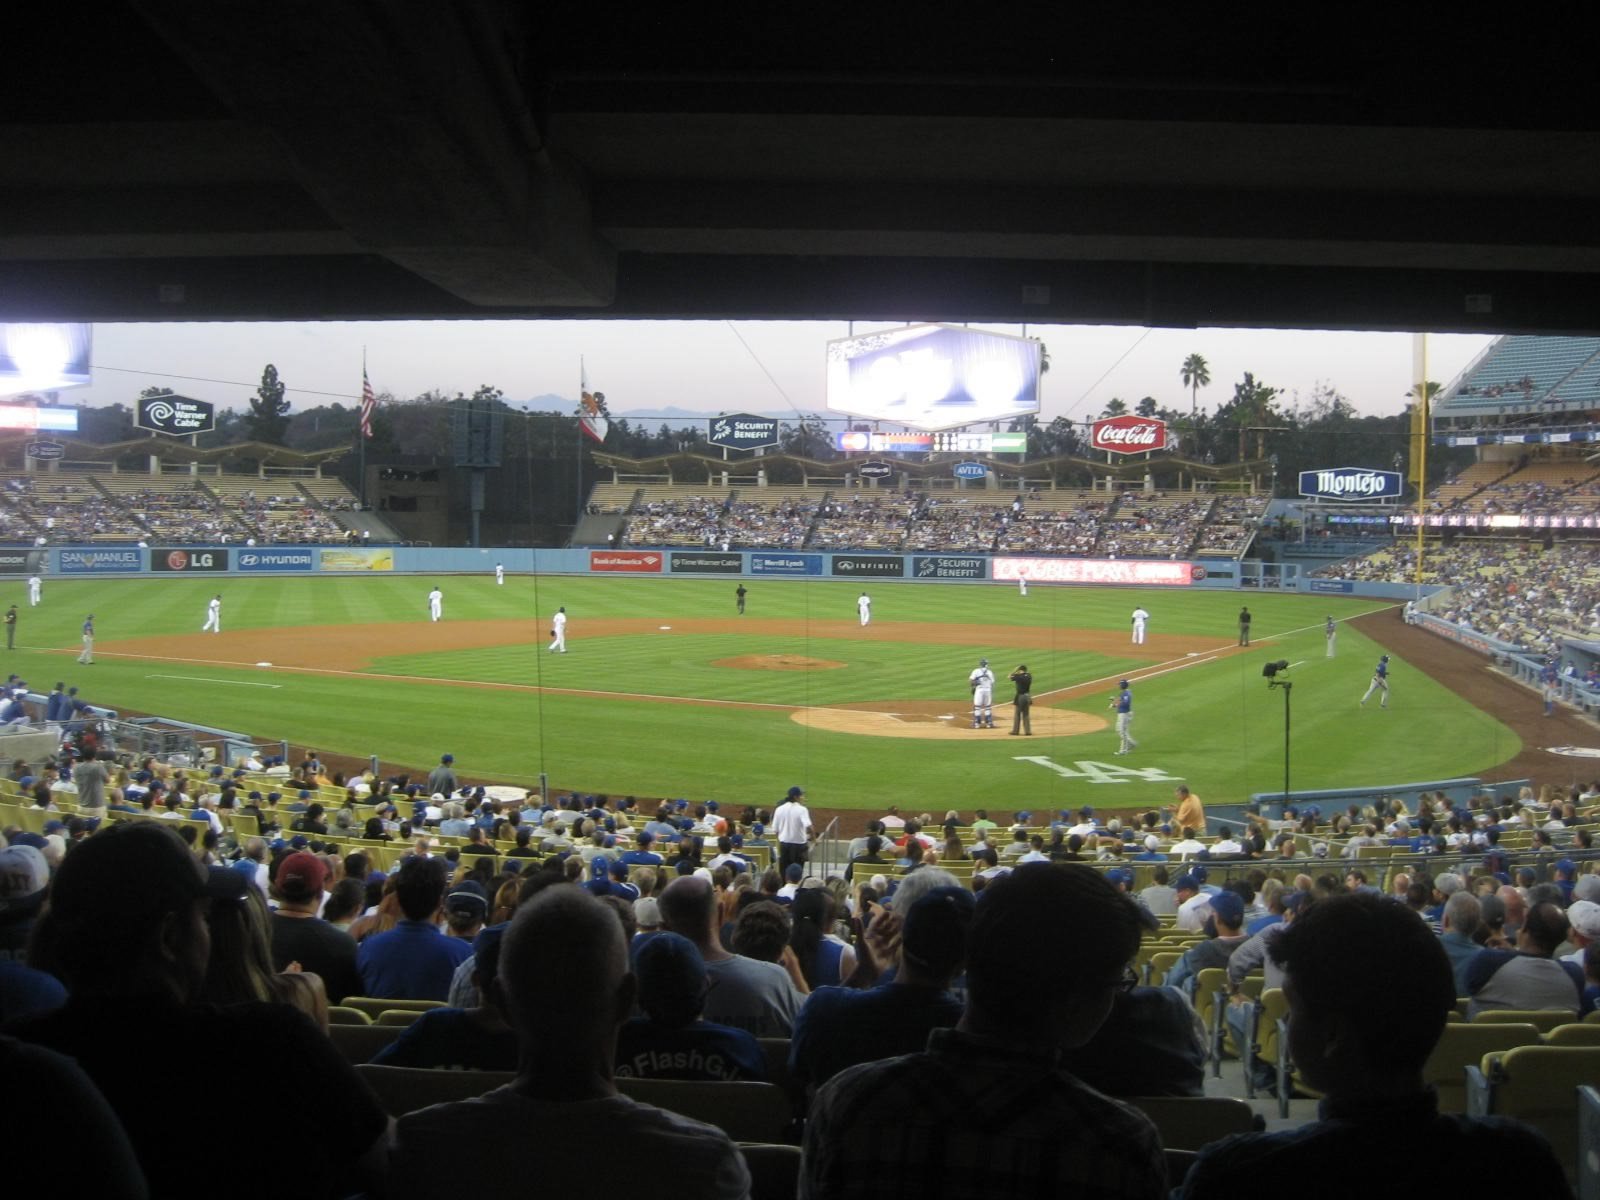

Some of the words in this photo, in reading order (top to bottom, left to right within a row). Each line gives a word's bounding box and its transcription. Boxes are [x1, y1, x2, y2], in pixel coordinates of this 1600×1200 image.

[174, 402, 198, 411] Time
[174, 411, 207, 420] Warner
[174, 419, 200, 427] Cable
[734, 422, 774, 430] SECURITY
[1316, 472, 1385, 495] Montejo
[191, 555, 213, 567] LG
[261, 556, 311, 564] HYUNDAI
[937, 559, 981, 568] SECURITY
[937, 569, 975, 577] BENEFIT
